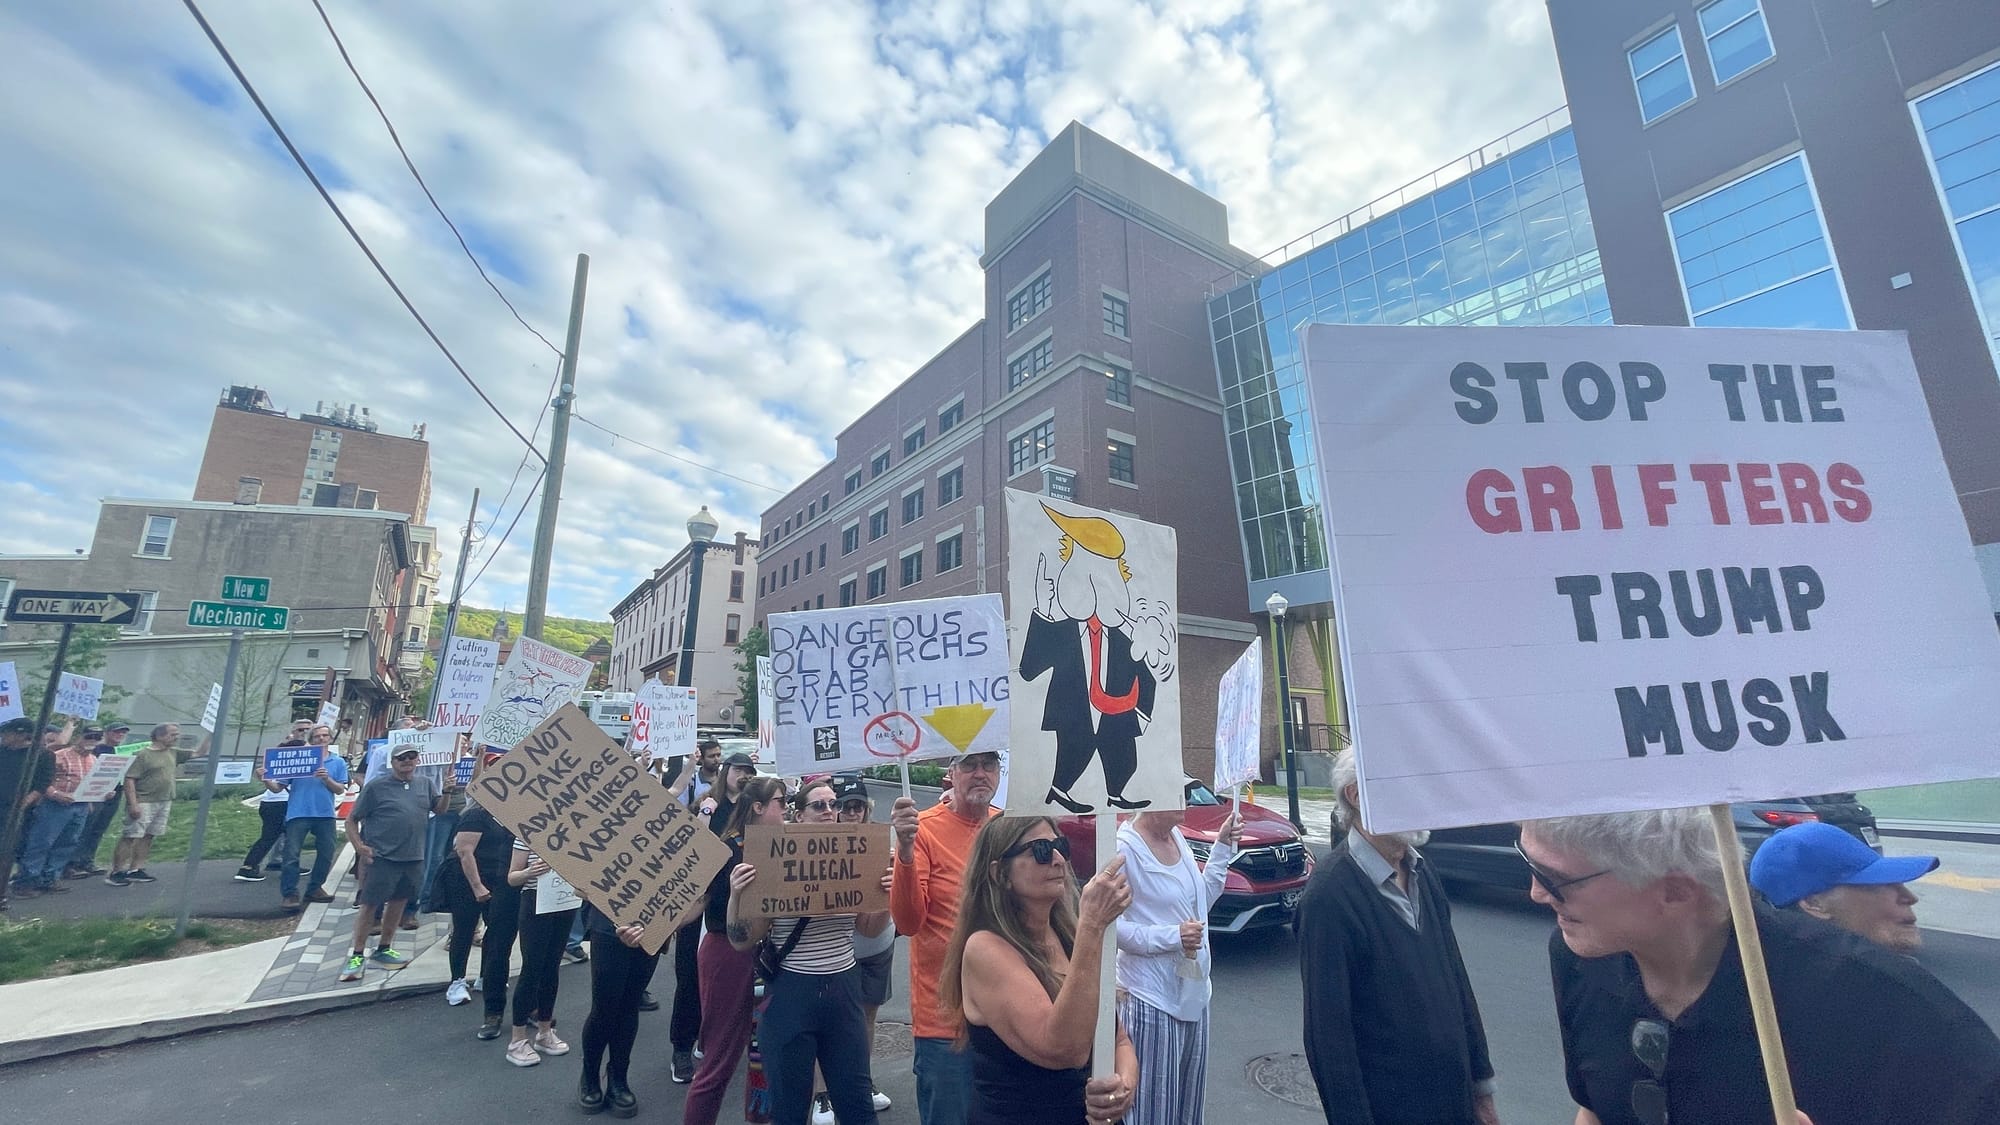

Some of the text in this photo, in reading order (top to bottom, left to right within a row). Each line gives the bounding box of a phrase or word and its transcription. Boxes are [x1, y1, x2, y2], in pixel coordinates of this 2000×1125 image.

[1449, 360, 1845, 424] STOP THE
[1465, 462, 1873, 534] GRIFTERS
[224, 579, 267, 598] S New St
[1555, 564, 1826, 642] TRUMP
[22, 599, 109, 615] ONE WAY
[194, 604, 283, 627] Mechanic St
[771, 610, 963, 653] DANGEOUS
[448, 654, 470, 667] funds
[471, 656, 482, 668] for
[456, 640, 488, 657] Cutting
[771, 631, 989, 675] OLIGARCHS
[72, 678, 88, 691] NO
[452, 669, 483, 683] Children
[774, 669, 869, 700] GRAB
[775, 676, 1010, 727] EVERYTHING
[1614, 670, 1847, 758] MUSK
[434, 702, 480, 733] No Way
[677, 713, 695, 729] NOT
[394, 732, 433, 744] PROTECT
[524, 717, 573, 766] NOT
[270, 757, 318, 768] BILLIONAIRE
[278, 749, 312, 759] STOP THE
[273, 766, 311, 776] TAKEOVER
[518, 749, 582, 801] TAKE
[518, 748, 620, 844] ADVANTAGE
[547, 765, 639, 851] OF A HIRED
[568, 789, 650, 862] WORKER
[590, 852, 633, 893] WHO
[631, 834, 650, 852] IS
[645, 803, 682, 839] POOR
[770, 836, 867, 858] NO ONE IS
[783, 858, 862, 882] ILLEGAL
[608, 879, 642, 917] AND
[630, 848, 700, 929] DEUTERONOMY
[761, 890, 864, 913] STOLEN LAND
[803, 883, 819, 893] ON
